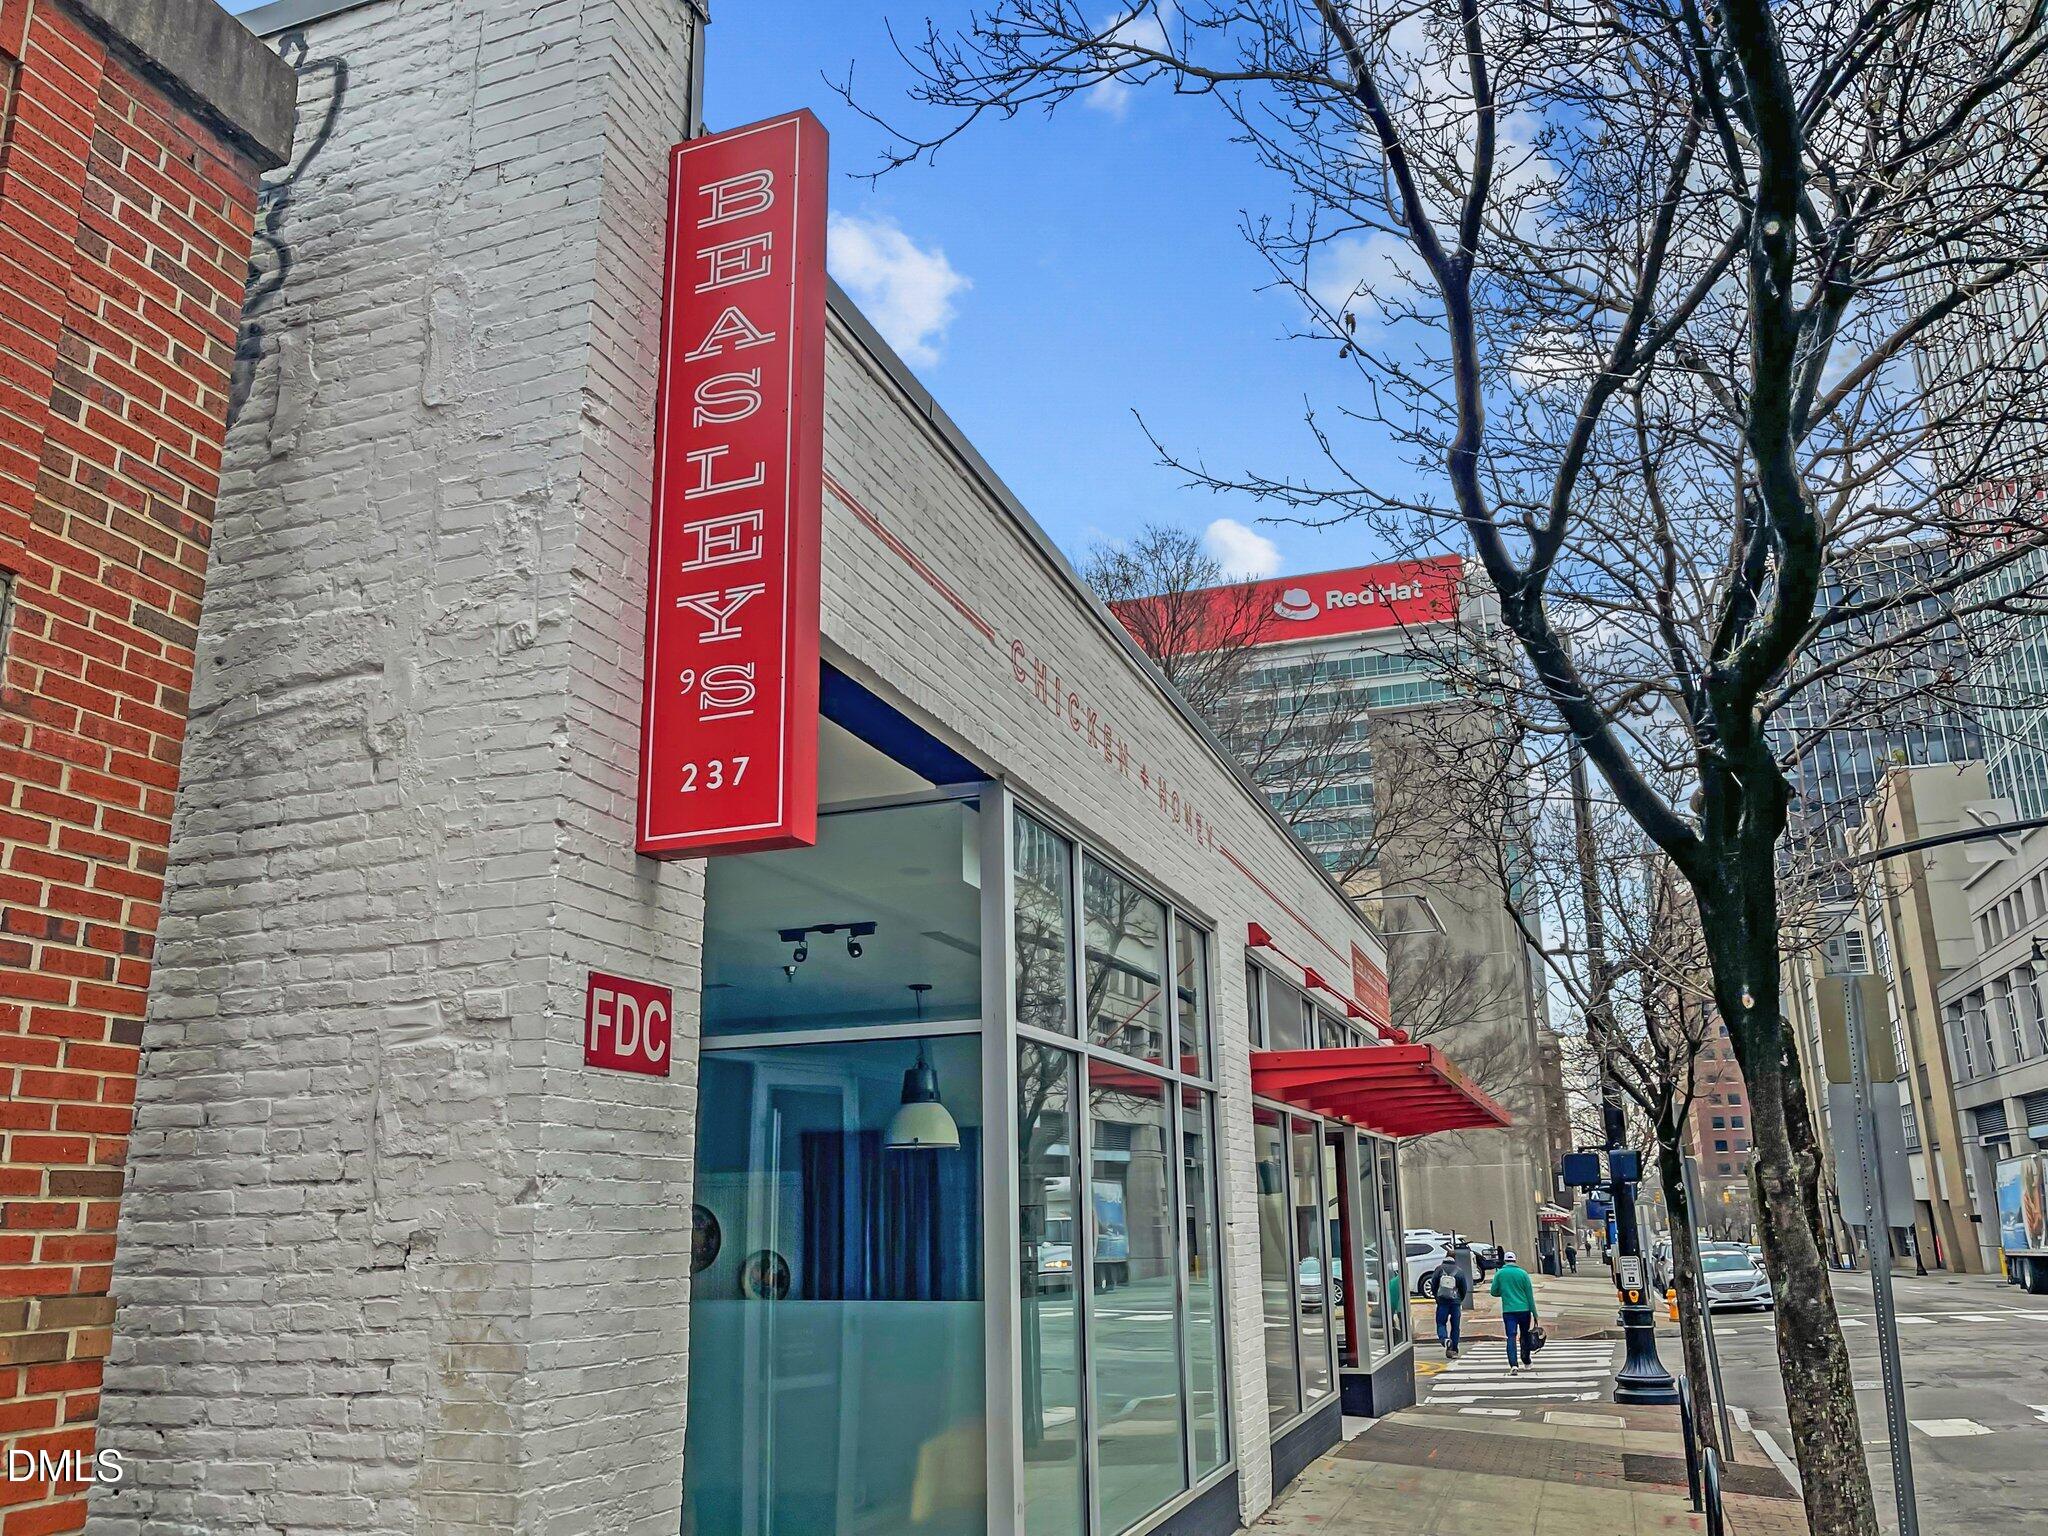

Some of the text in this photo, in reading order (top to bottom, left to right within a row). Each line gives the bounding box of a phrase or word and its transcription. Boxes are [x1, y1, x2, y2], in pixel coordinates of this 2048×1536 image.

[1325, 579, 1424, 610] Red Hat
[1010, 638, 1130, 777] CHICKEN
[1157, 775, 1214, 853] HONEY
[680, 756, 750, 793] 237
[590, 987, 667, 1062] FDC
